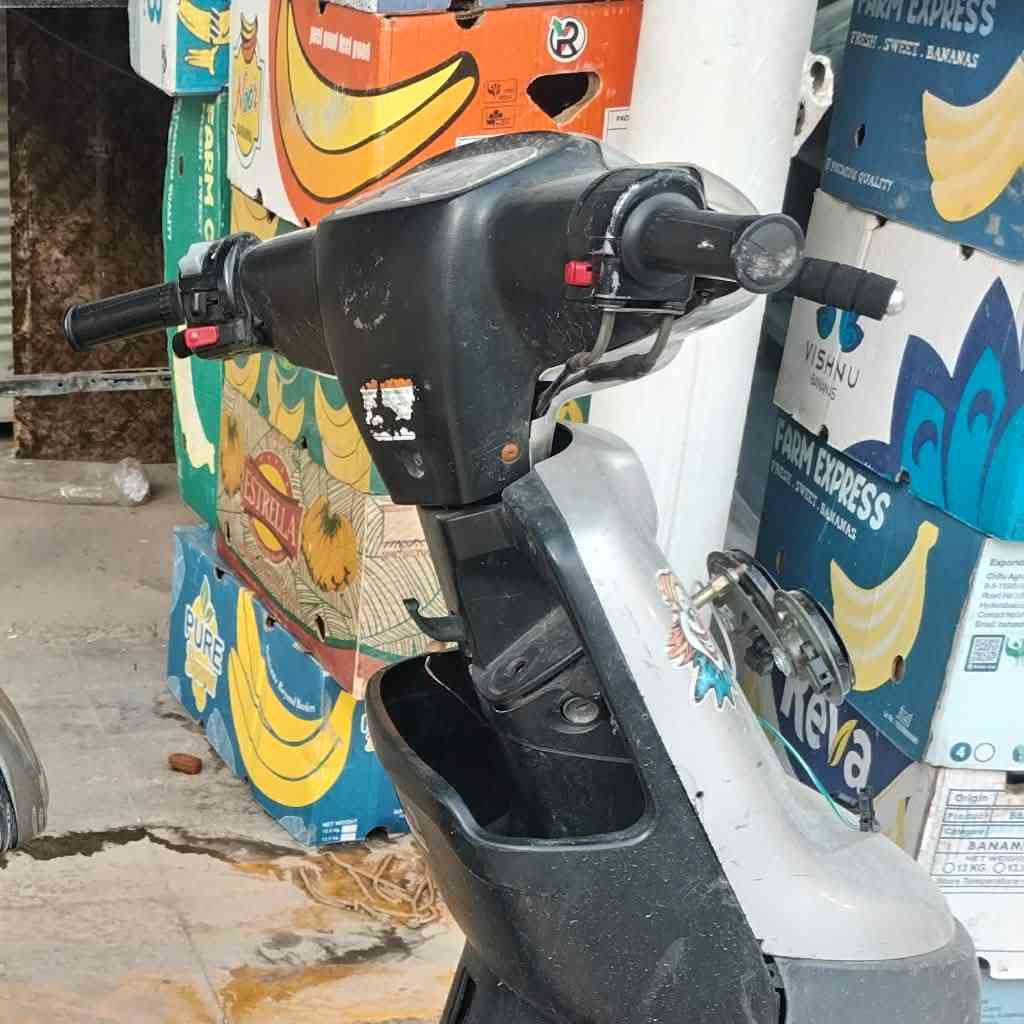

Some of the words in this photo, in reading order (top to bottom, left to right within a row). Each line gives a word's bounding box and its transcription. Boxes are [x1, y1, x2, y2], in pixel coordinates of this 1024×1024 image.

[906, 0, 995, 37] EXPRESS
[850, 31, 878, 49] FRESH
[883, 37, 921, 57] SWEET
[926, 45, 980, 68] BANANAS
[204, 103, 215, 207] FARM
[805, 341, 860, 388] VISHNU
[775, 418, 816, 476] FARM
[814, 448, 891, 530] EXPRESS
[239, 462, 297, 547] ESTRELLA
[820, 502, 857, 541] BANANAS
[184, 603, 225, 675] PURE
[955, 793, 989, 805] Origin
[967, 841, 1024, 851] BANAN
